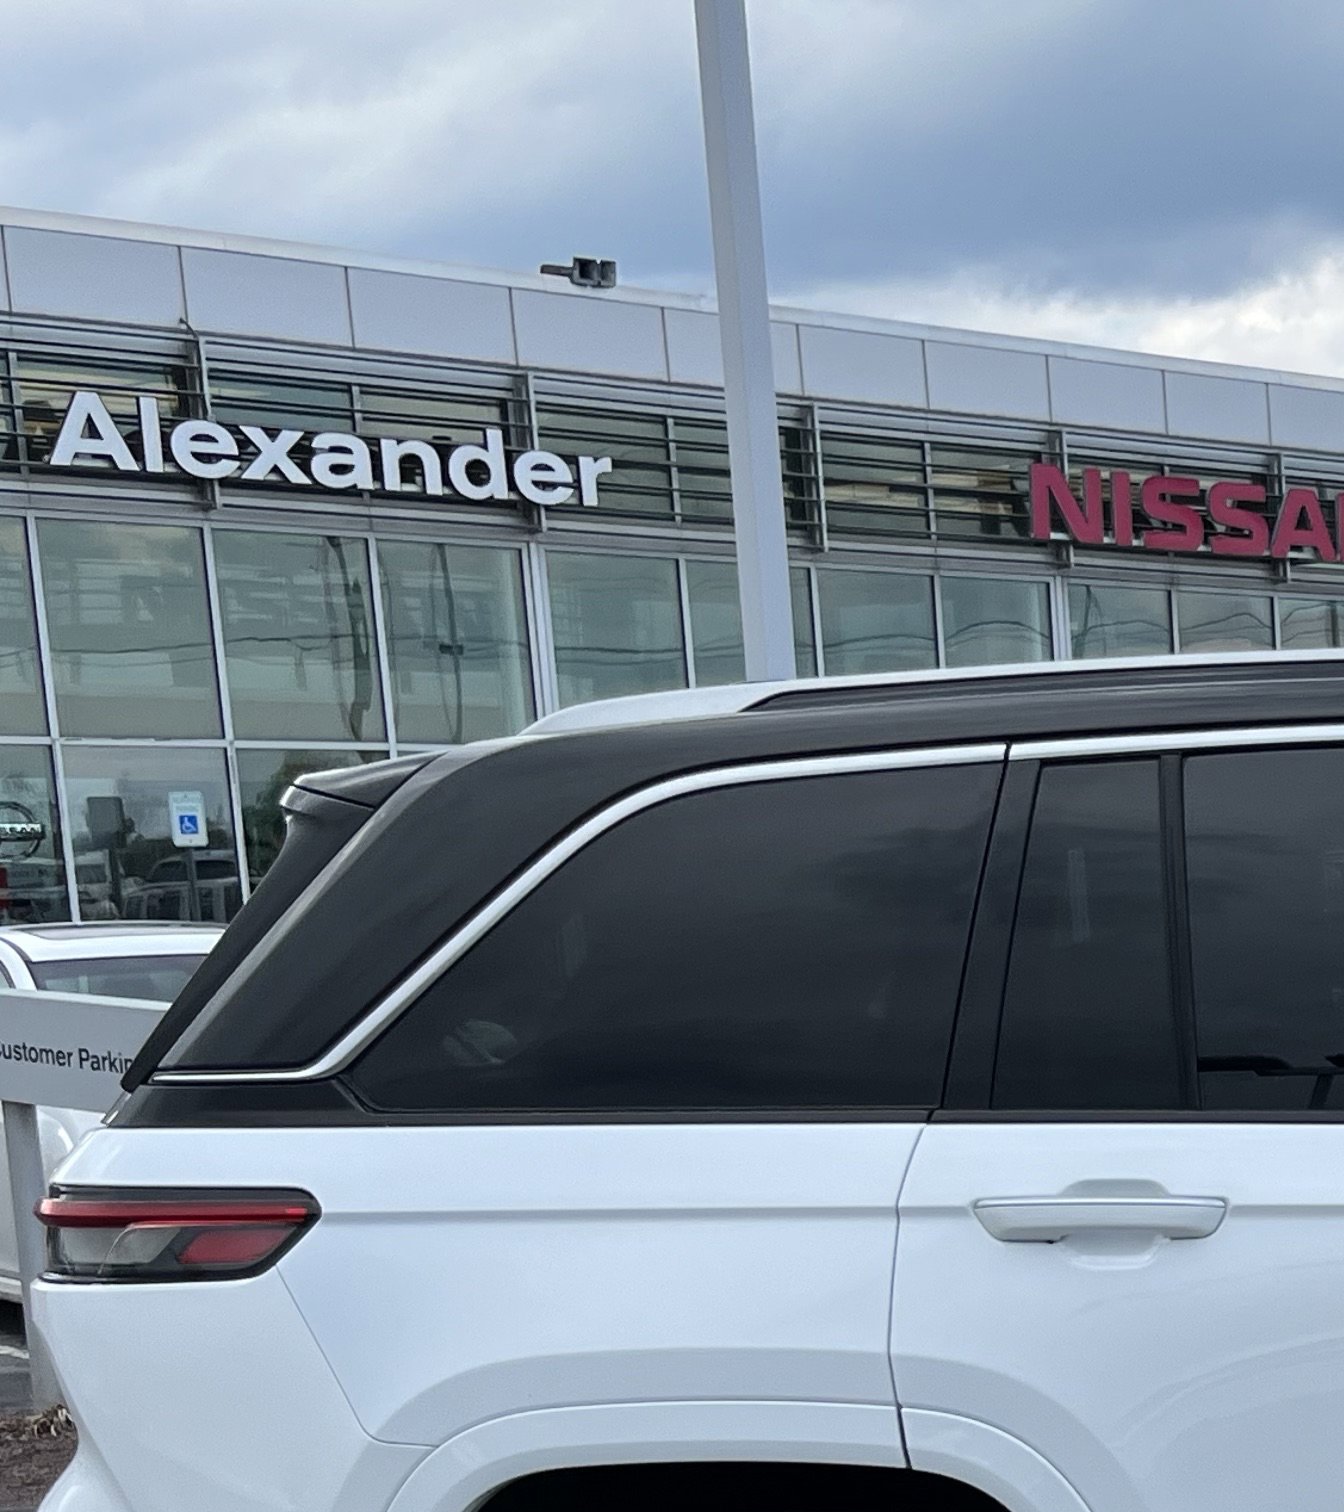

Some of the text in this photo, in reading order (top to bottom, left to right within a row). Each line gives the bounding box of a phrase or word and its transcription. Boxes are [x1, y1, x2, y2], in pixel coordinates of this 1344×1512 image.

[50, 390, 612, 506] Alexander
[0, 1042, 136, 1074] ustomer Parkin
